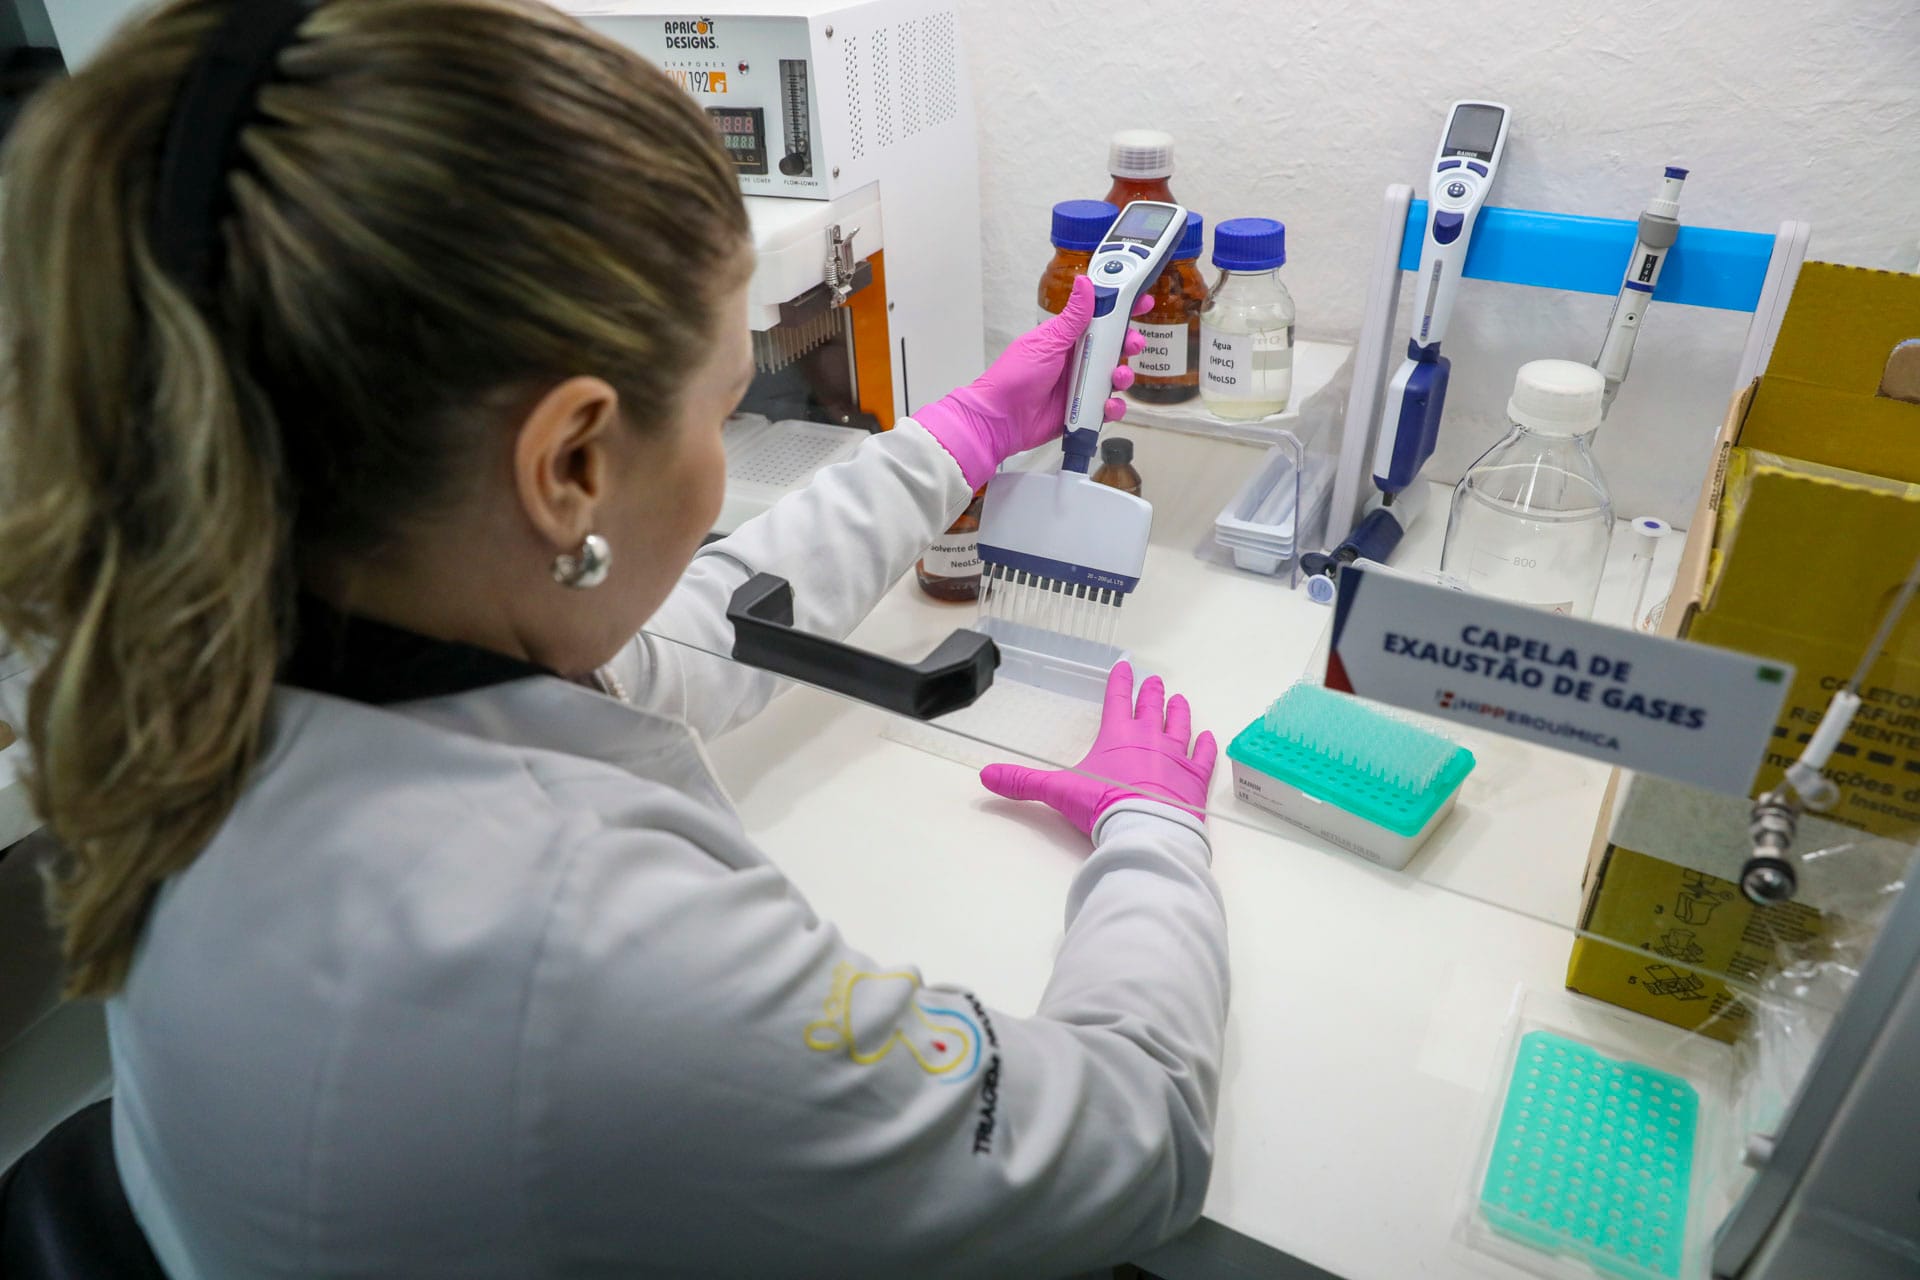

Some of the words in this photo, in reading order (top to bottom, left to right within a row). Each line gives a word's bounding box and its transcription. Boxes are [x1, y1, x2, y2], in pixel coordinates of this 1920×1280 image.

[1138, 329, 1173, 339] Metanol
[1142, 346, 1168, 356] (HPLC)
[1212, 339, 1232, 351] Água
[1139, 361, 1171, 371] NeoLSD
[1210, 356, 1234, 369] (HPLC)
[1208, 372, 1236, 385] NeoLSD
[1513, 557, 1537, 568] 800
[1461, 625, 1578, 671] CAPELA
[1588, 656, 1633, 683] DE
[1383, 633, 1544, 689] EXAUSTÃO
[1552, 675, 1595, 702] DE
[1602, 688, 1707, 730] GASES
[1459, 698, 1620, 750] HIPPERQUÍMICA
